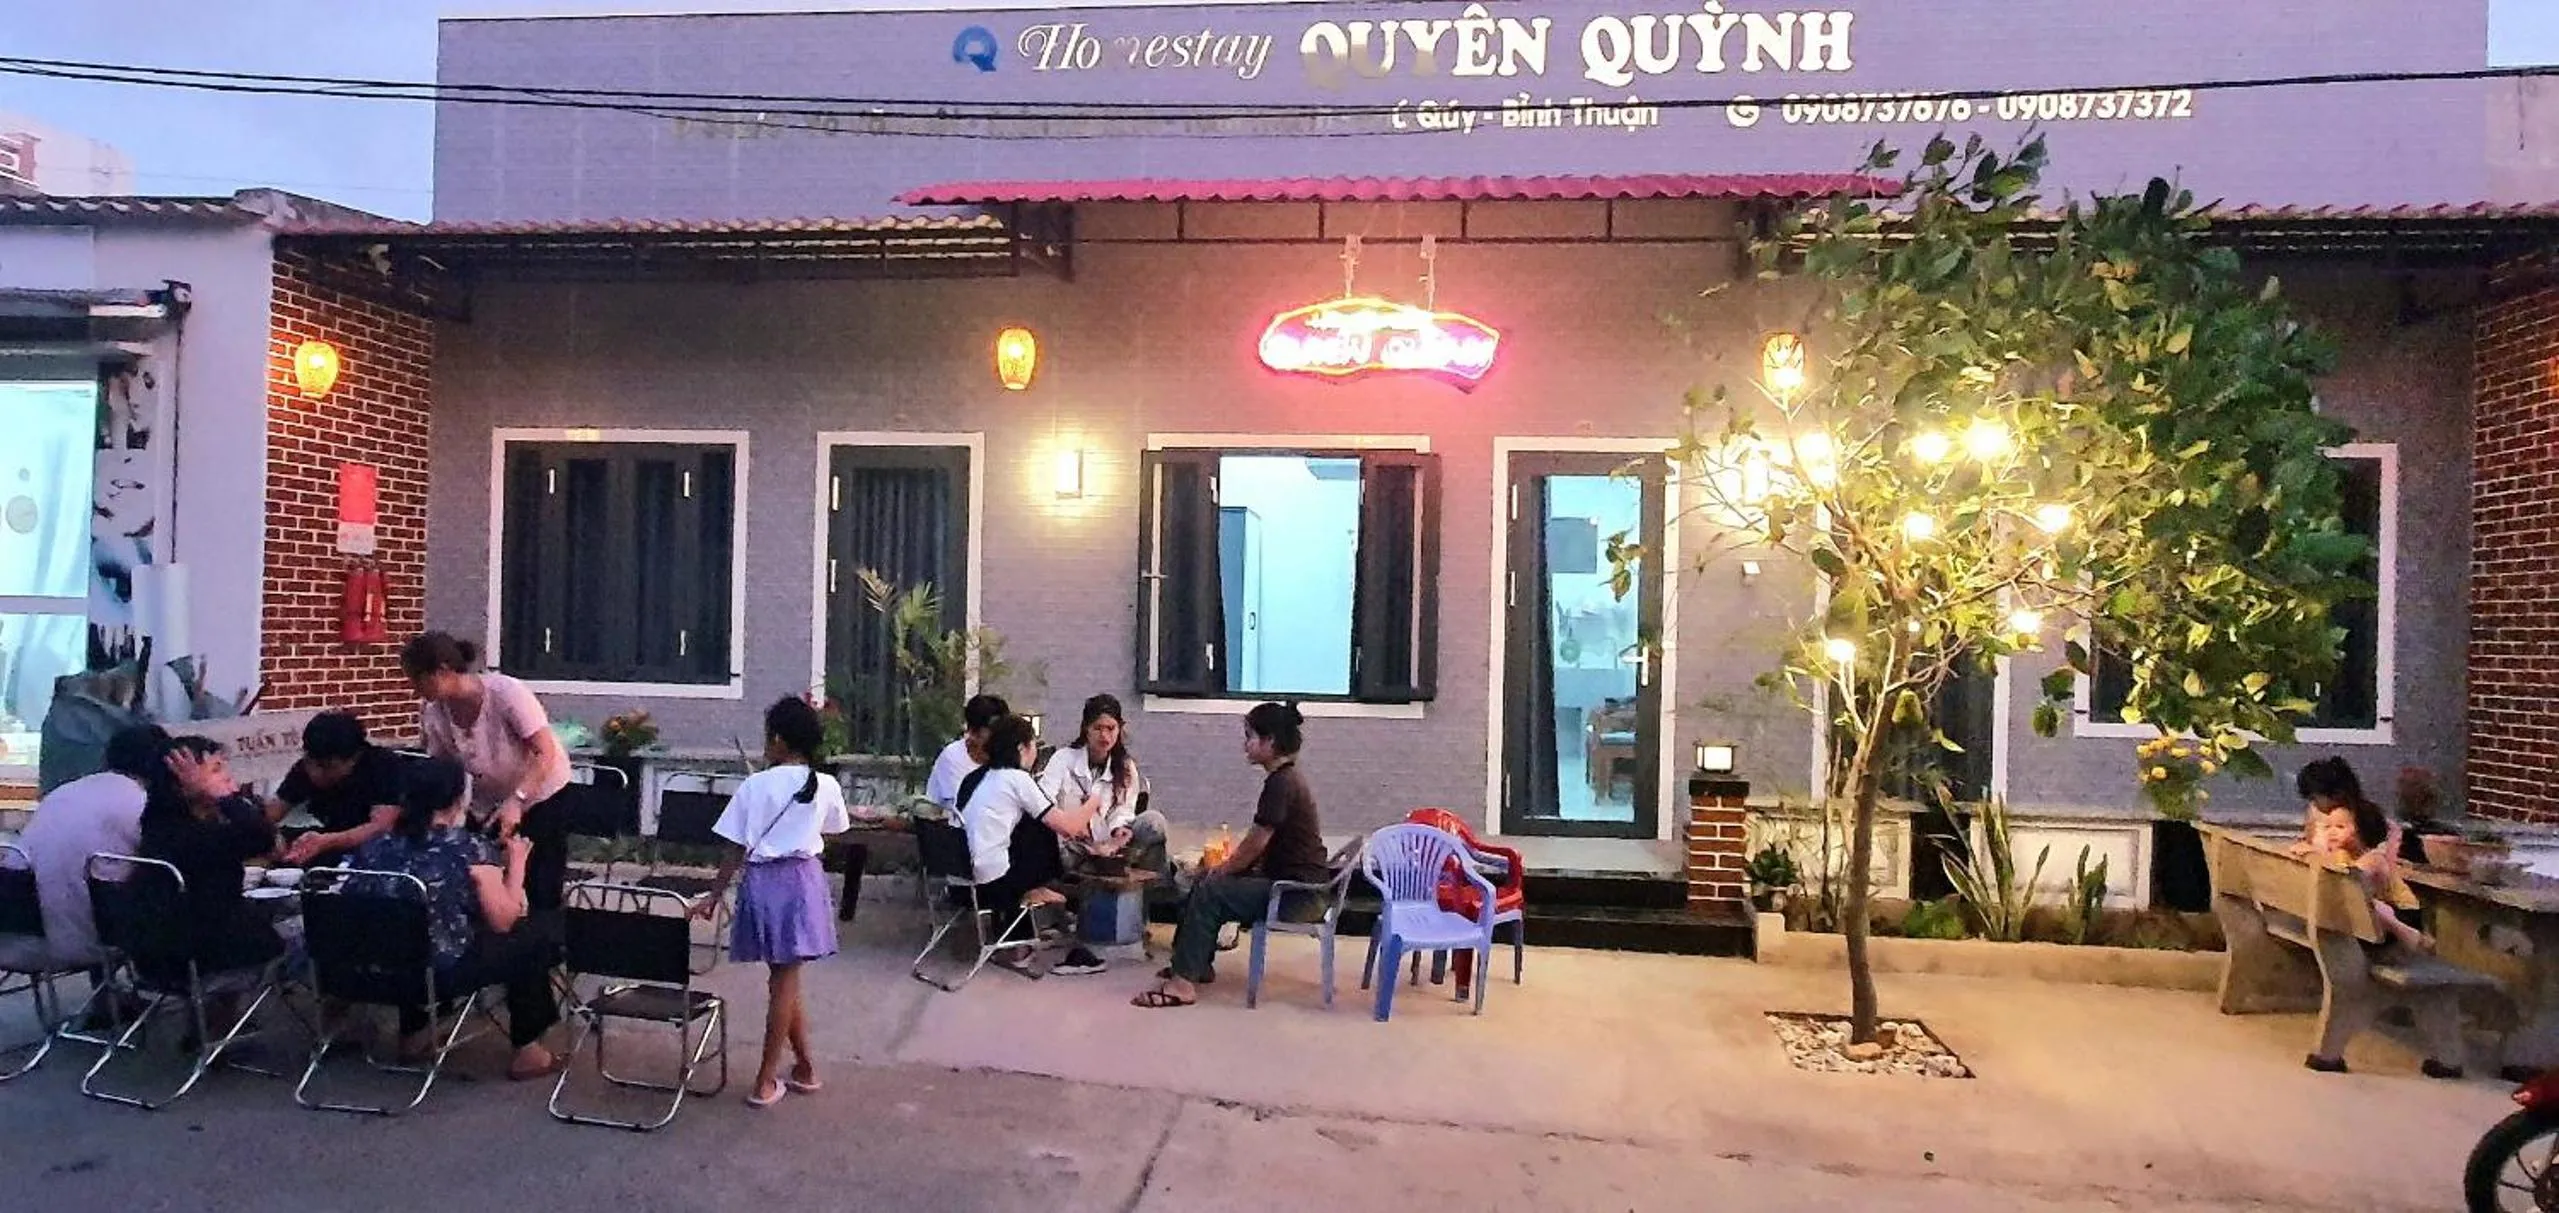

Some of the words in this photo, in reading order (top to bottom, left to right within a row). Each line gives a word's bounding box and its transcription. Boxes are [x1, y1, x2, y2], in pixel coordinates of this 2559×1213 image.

[1299, 2, 1552, 90] QUYÊN
[1580, 0, 1854, 87] QUỲNH
[1997, 89, 2192, 121] 0908737372
